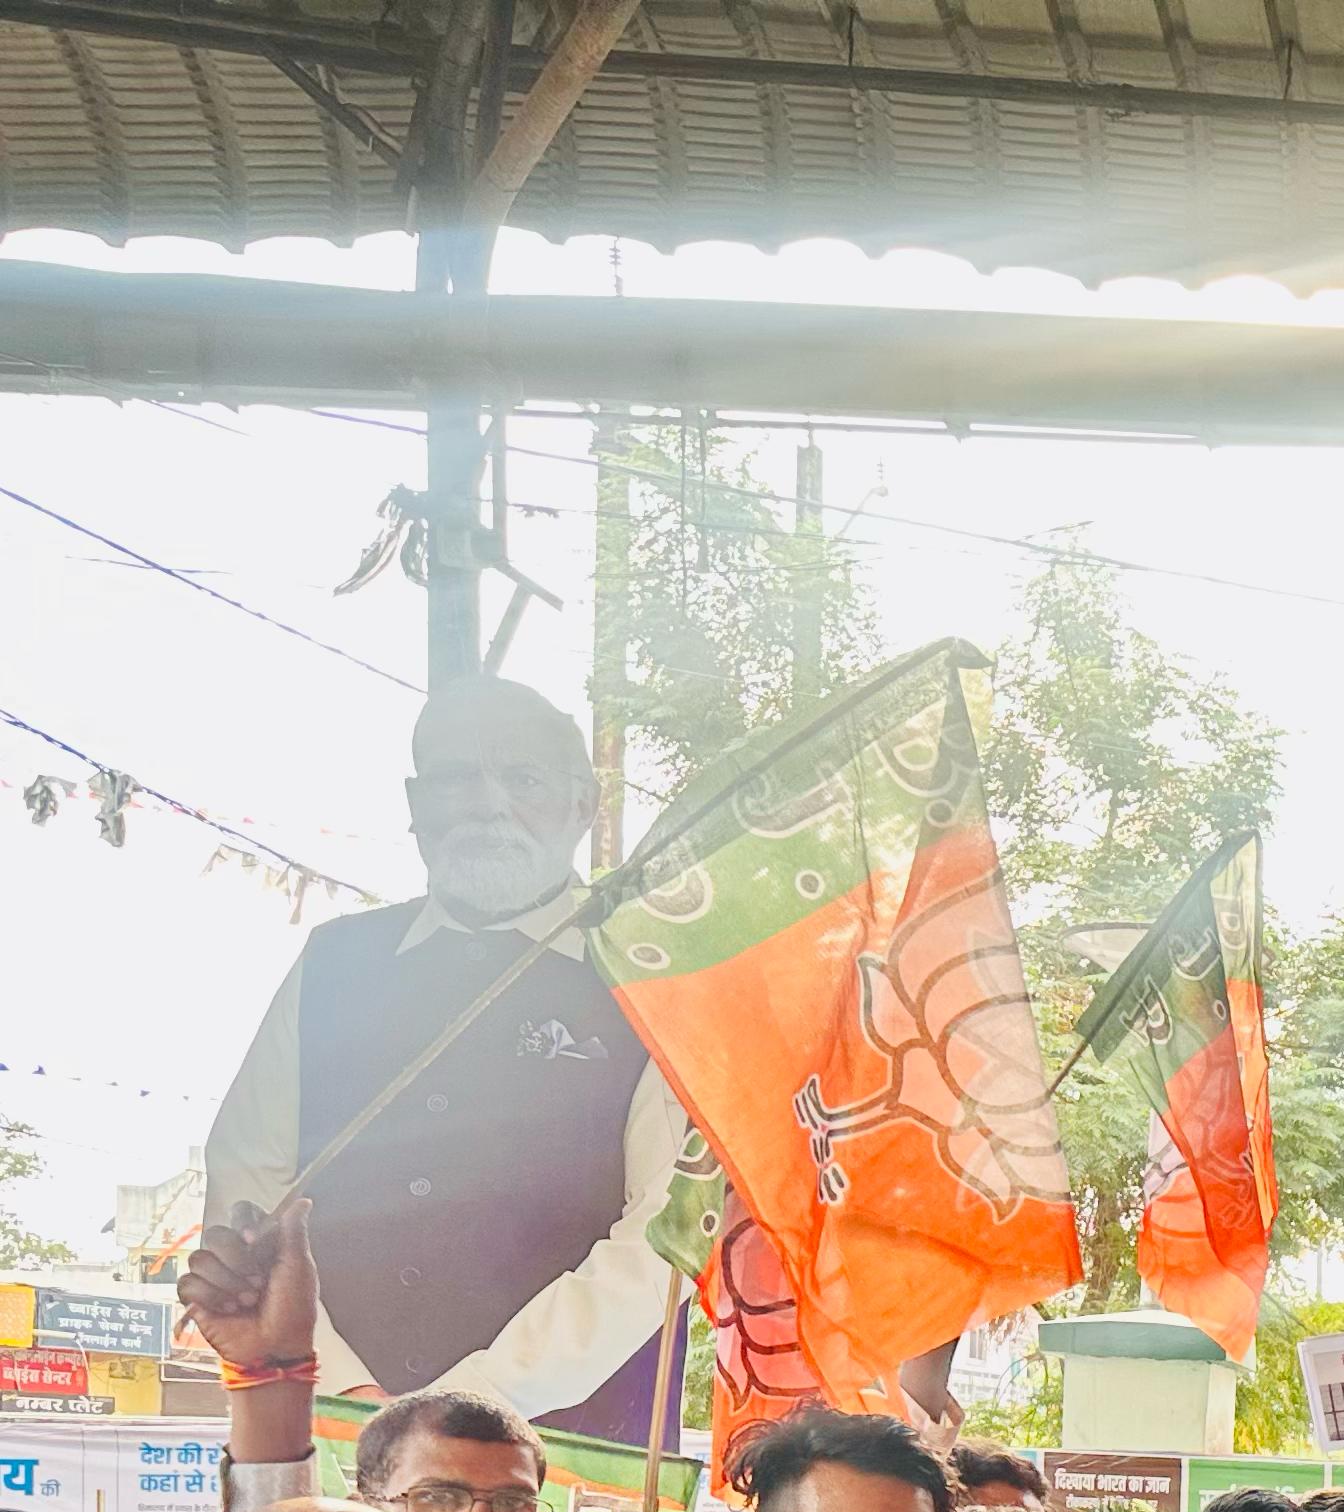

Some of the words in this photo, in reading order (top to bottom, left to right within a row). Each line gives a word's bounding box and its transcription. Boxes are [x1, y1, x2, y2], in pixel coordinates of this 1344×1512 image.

[15, 1397, 64, 1412] नम्बर
[138, 1441, 171, 1465] देश
[176, 1441, 202, 1465] की
[40, 1479, 61, 1497] की
[138, 1471, 181, 1493] कहां
[184, 1470, 206, 1493] से
[1055, 1467, 1096, 1491] दिखाया
[1097, 1474, 1126, 1493] भारत
[1128, 1475, 1144, 1494] का
